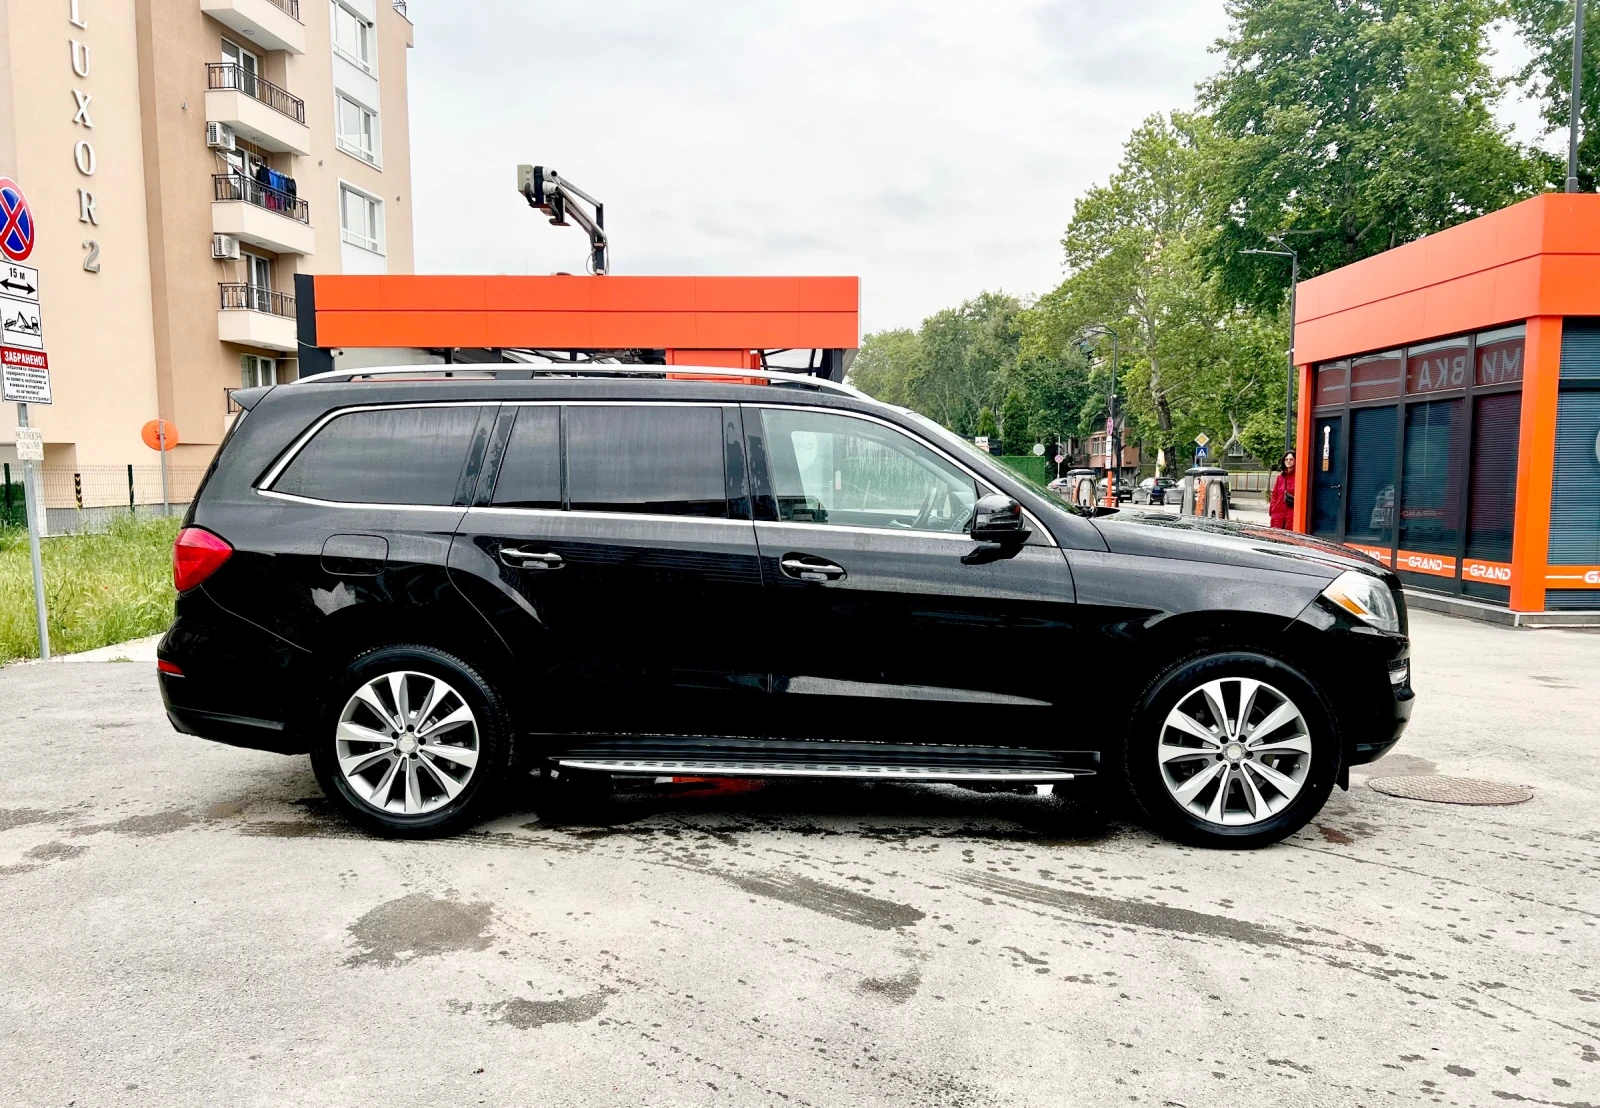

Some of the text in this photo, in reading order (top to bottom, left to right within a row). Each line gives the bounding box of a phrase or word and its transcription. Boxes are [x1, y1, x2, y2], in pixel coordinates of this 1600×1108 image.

[69, 0, 101, 274] LUXOR 2
[9, 267, 18, 279] 15
[4, 350, 46, 367] ЗАБРАНЕНО!
[1408, 555, 1443, 571] GRAND
[1469, 564, 1511, 581] GRAND
